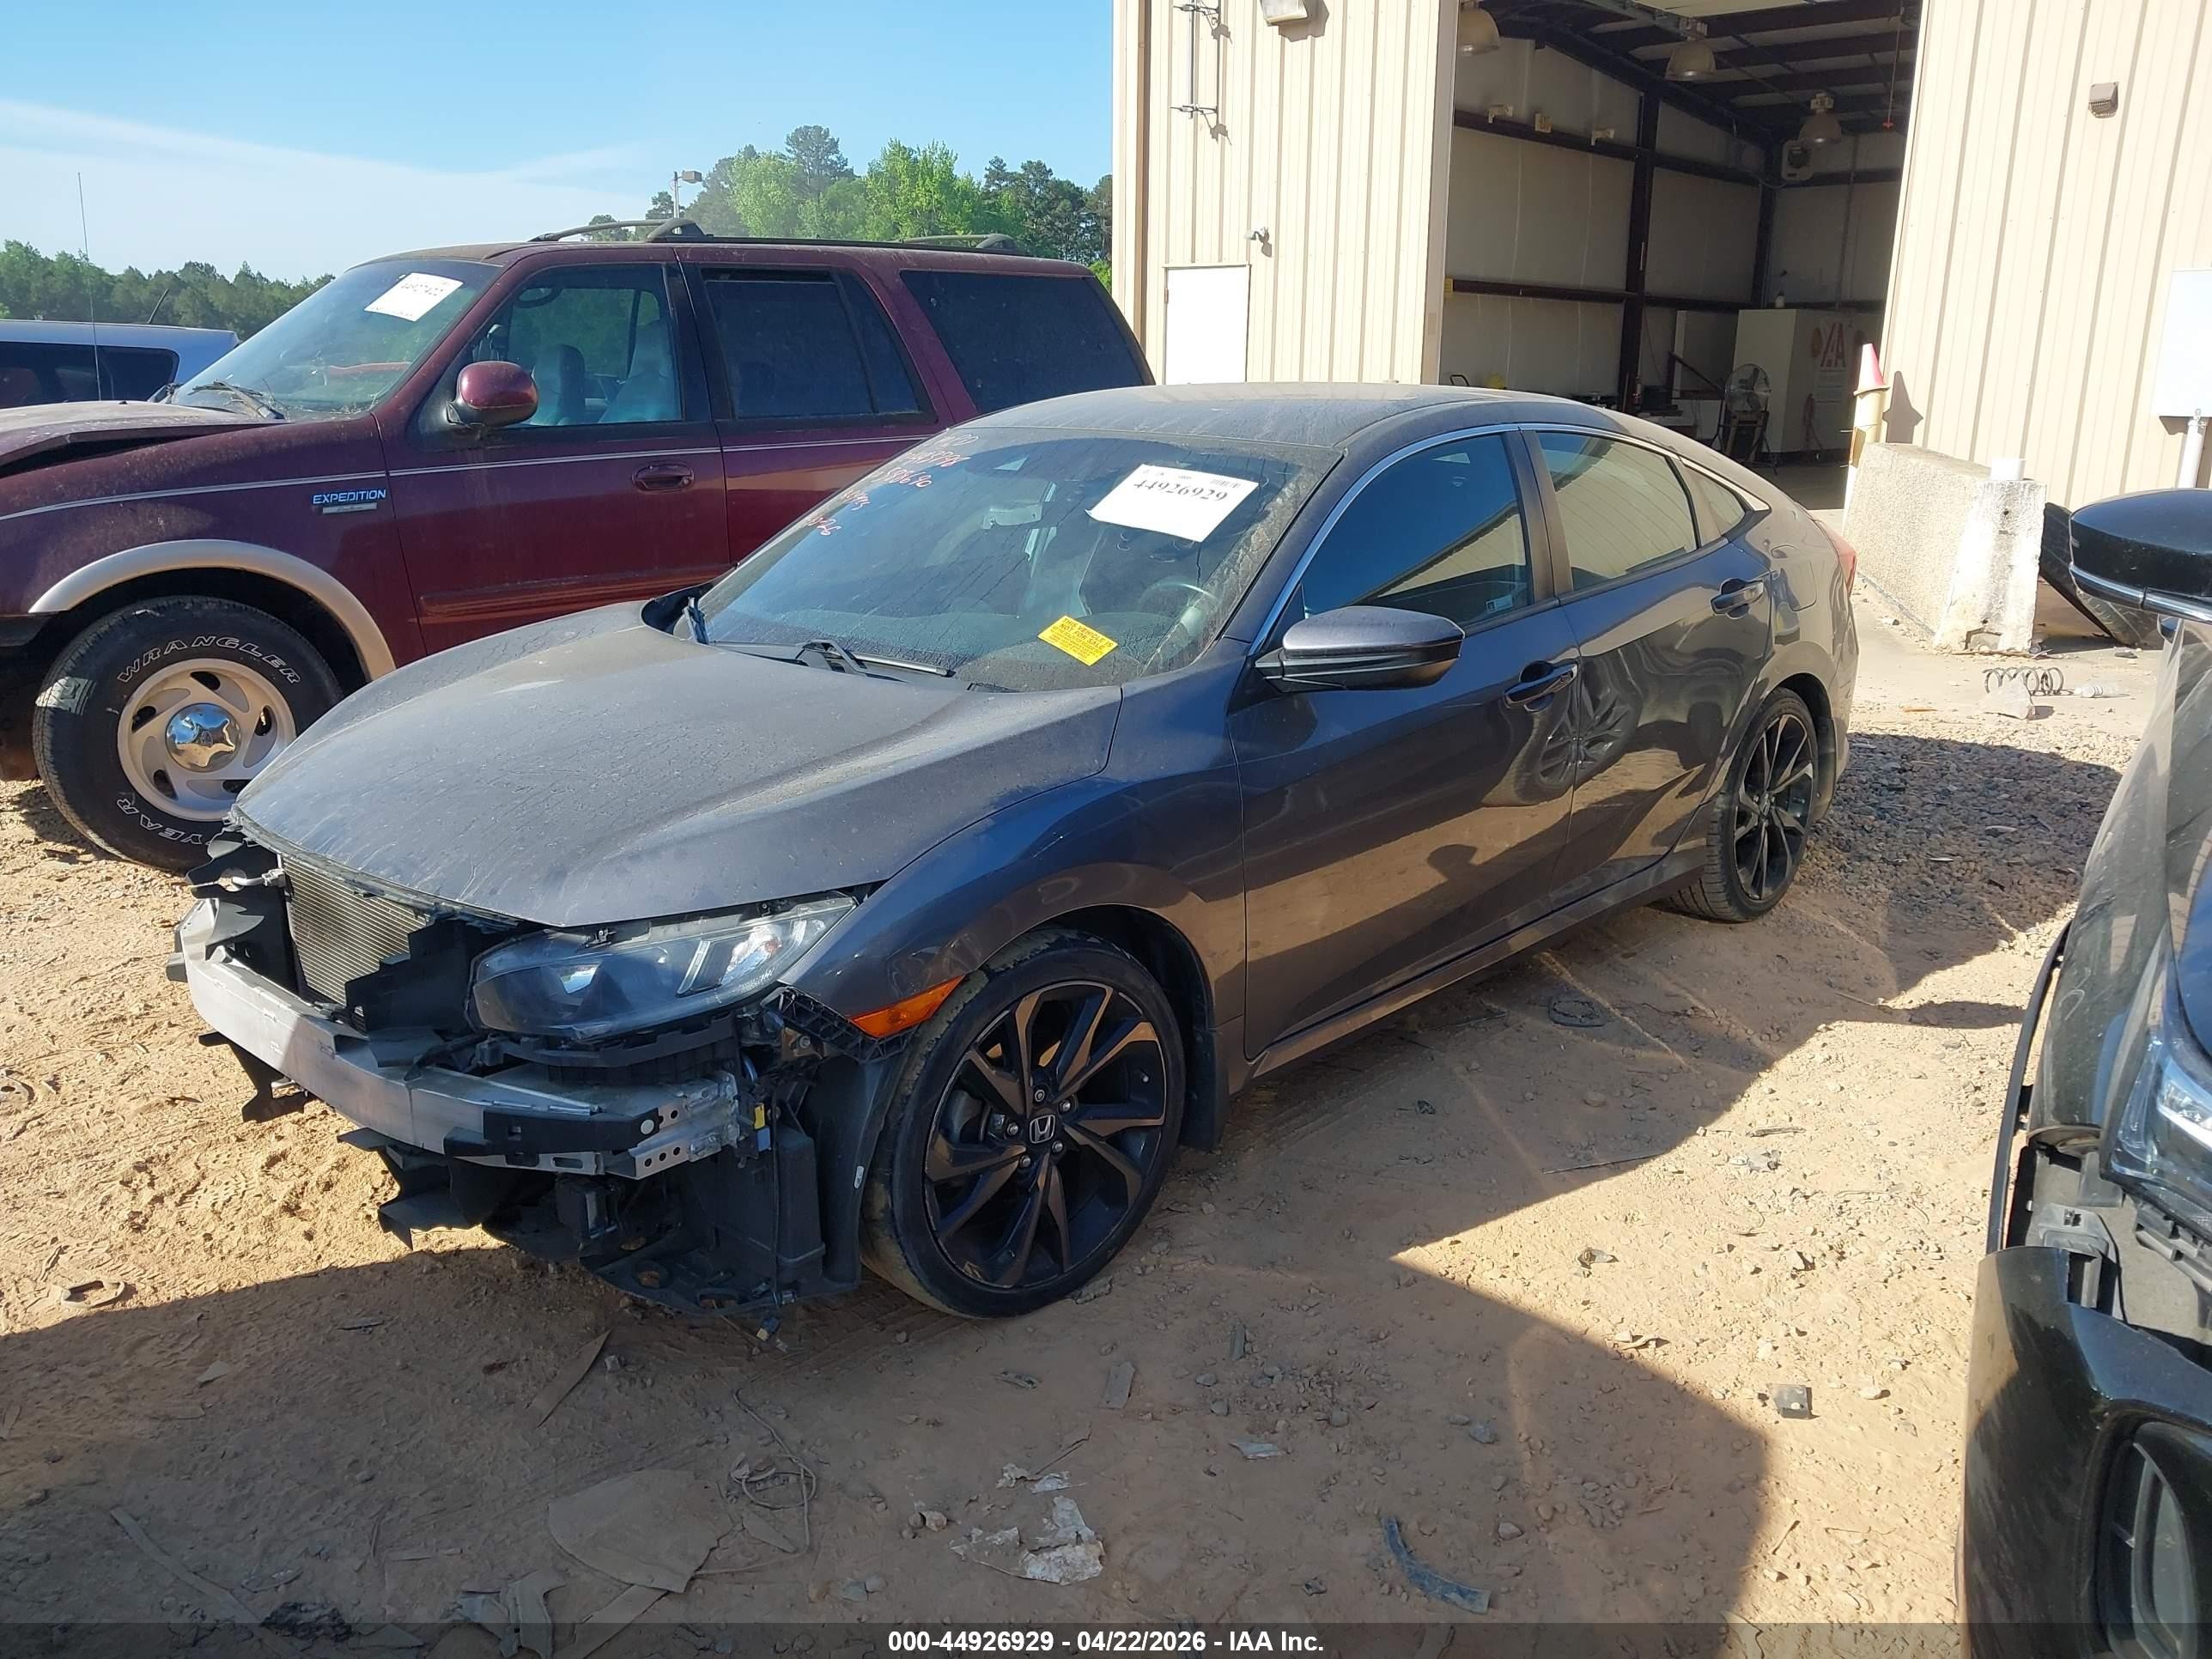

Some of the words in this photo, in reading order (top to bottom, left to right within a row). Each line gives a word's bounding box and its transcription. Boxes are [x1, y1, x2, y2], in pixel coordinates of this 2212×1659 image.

[313, 489, 386, 504] EXPEDITION
[1133, 479, 1228, 501] 44926929
[1060, 623, 1074, 632] NOT
[1074, 630, 1087, 640] FOR
[1086, 638, 1105, 649] SALE
[1063, 617, 1078, 628] THIS
[1078, 625, 1105, 642] VEHICLE
[117, 635, 301, 684] WRANGLER
